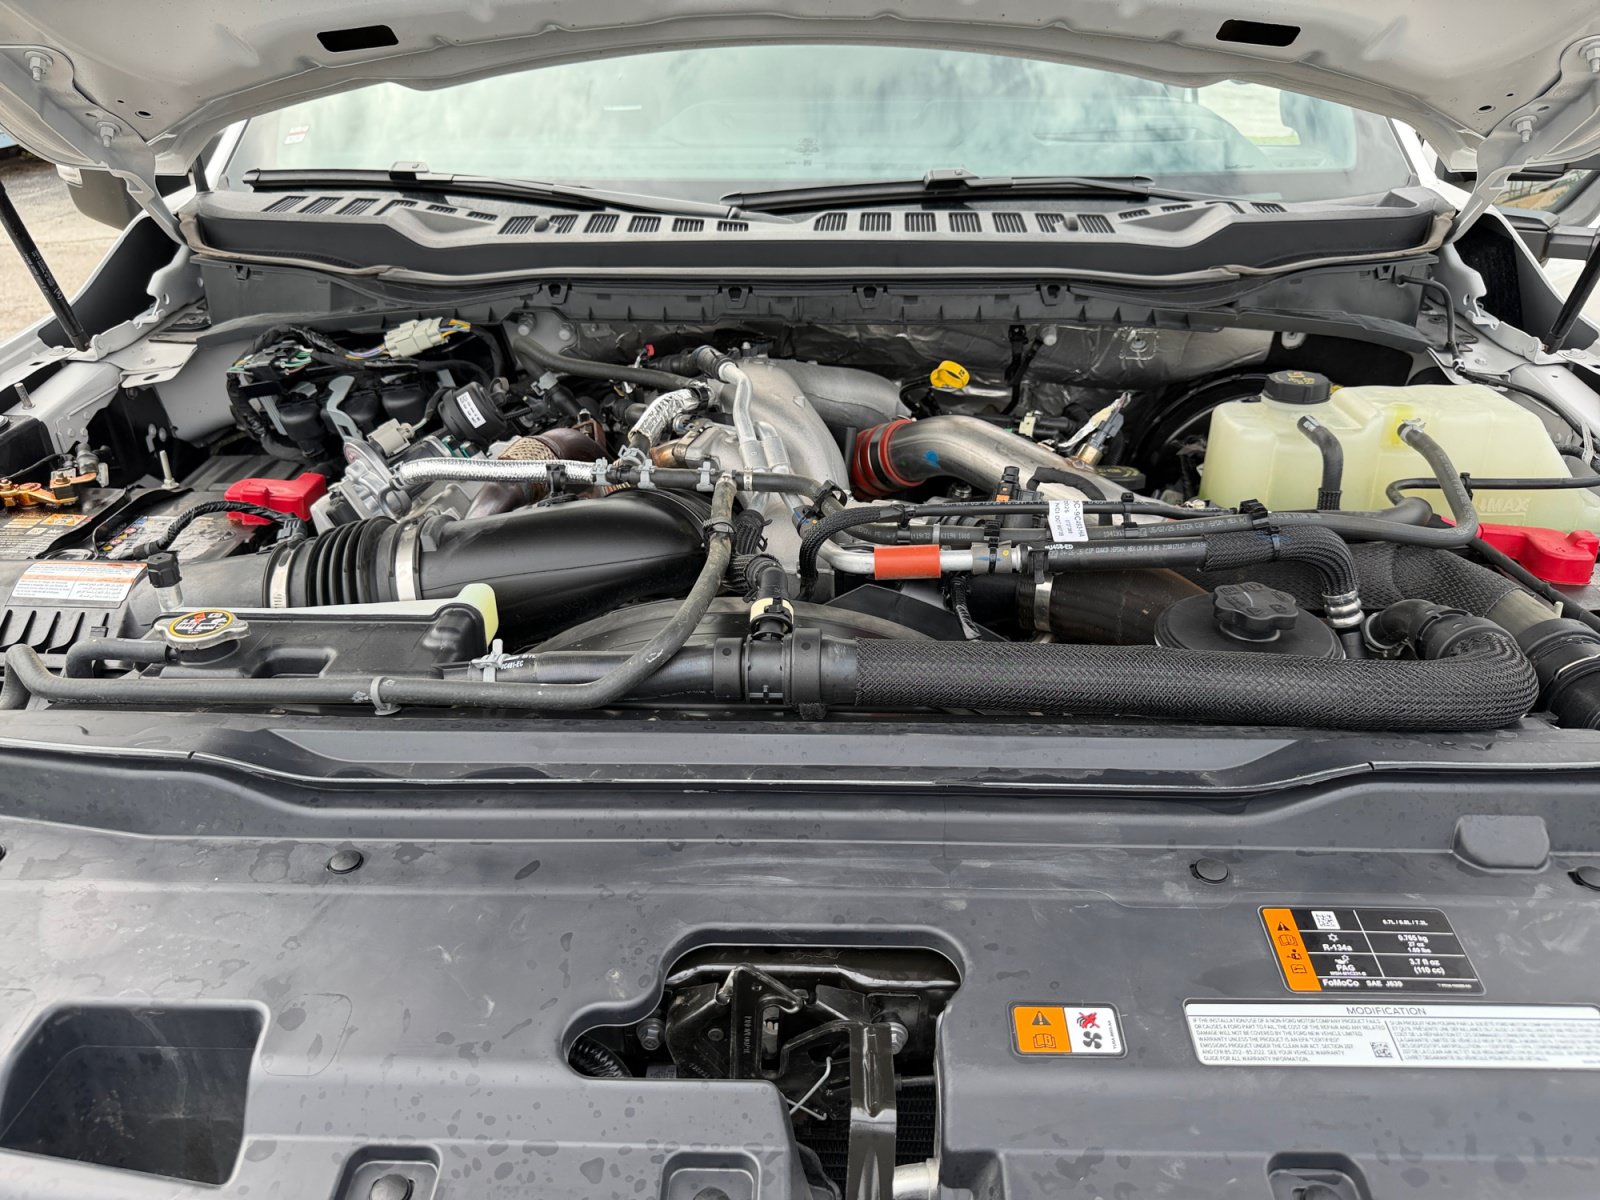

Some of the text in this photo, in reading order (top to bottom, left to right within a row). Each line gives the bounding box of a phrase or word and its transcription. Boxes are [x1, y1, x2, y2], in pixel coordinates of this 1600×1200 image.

[1418, 935, 1429, 943] kg
[1322, 943, 1353, 951] R-134a
[1414, 966, 1446, 975] (110 cc)
[1322, 978, 1403, 988] FoMoCo SAE J639
[1346, 1006, 1426, 1016] MODIFICATION
